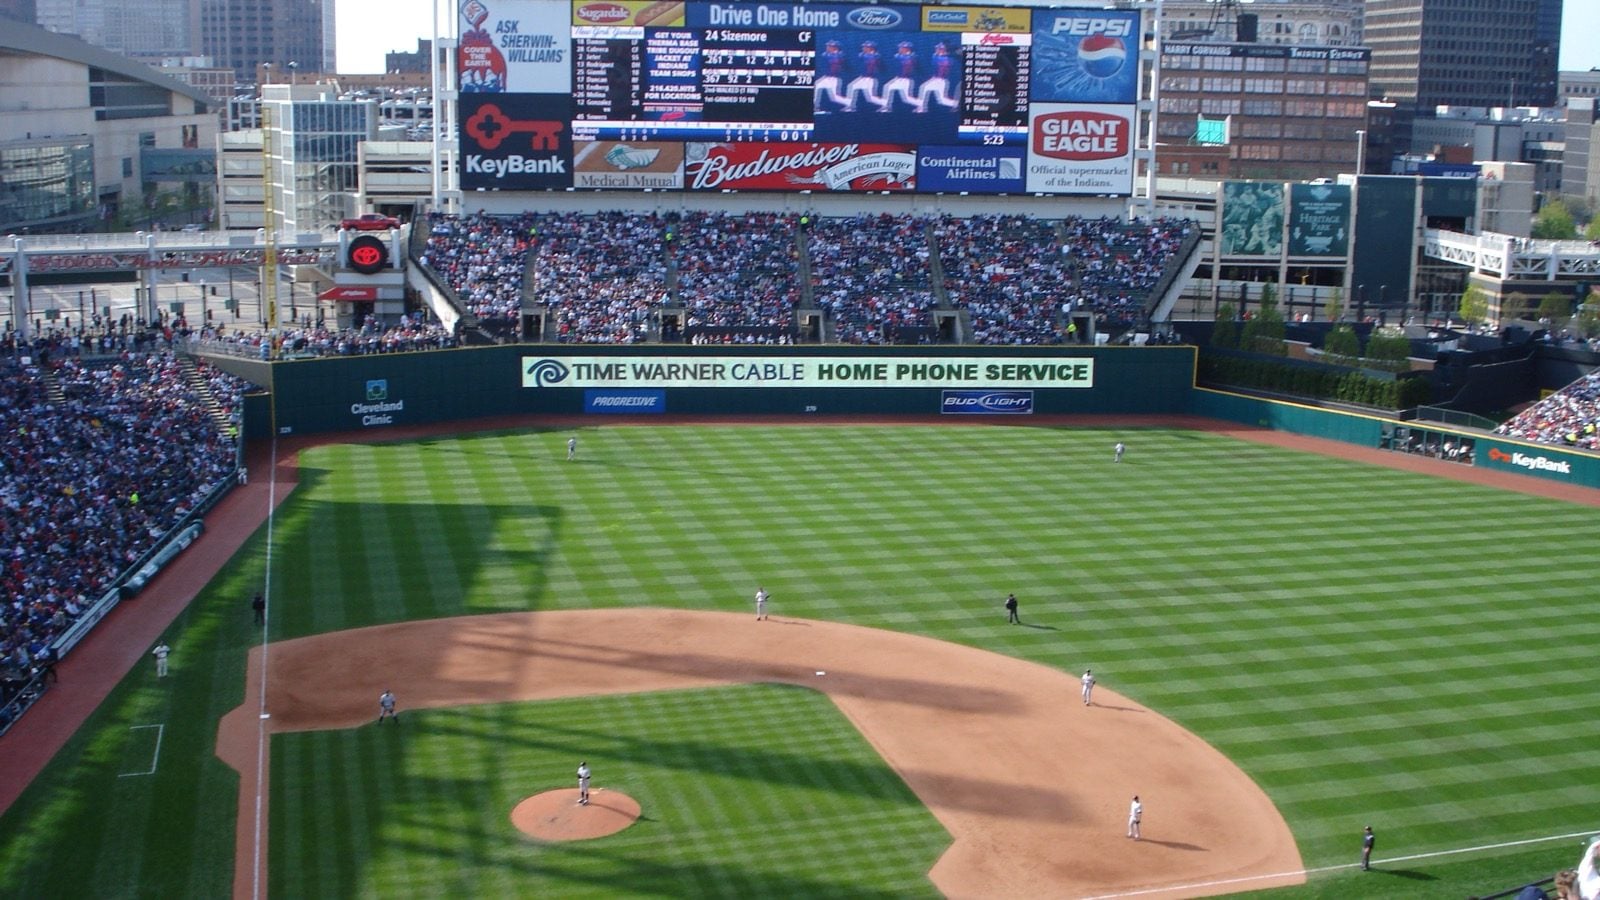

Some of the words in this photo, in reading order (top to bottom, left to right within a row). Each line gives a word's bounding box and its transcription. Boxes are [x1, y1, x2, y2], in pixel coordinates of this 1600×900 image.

[578, 7, 629, 20] Sugardale
[710, 5, 752, 25] Drive
[757, 6, 788, 26] One
[793, 6, 839, 27] Home
[857, 10, 890, 26] Ford
[496, 20, 520, 33] ASK
[1052, 17, 1132, 37] PEPSI
[501, 35, 557, 48] SHERWIN-
[705, 30, 718, 41] 24
[721, 30, 767, 42] Sizemore
[799, 32, 811, 42] CF
[508, 50, 563, 62] WILLIAMS
[1164, 46, 1191, 55] HARRY
[746, 56, 756, 64] 12
[764, 57, 774, 65] 24
[783, 57, 792, 65] 11
[794, 76, 812, 85] .370
[1042, 119, 1121, 136] GIANT
[781, 132, 788, 140] 0
[792, 132, 798, 140] 0
[803, 132, 808, 140] 1
[984, 135, 1004, 145] 5:23
[1043, 136, 1118, 152] EAGLE
[466, 154, 565, 177] KeyBank
[689, 144, 859, 189] Budweiser
[921, 157, 996, 168] Continental
[834, 161, 880, 182] American
[883, 159, 912, 171] Lager
[946, 169, 996, 179] Airlines
[1030, 165, 1066, 175] Official
[1069, 167, 1128, 177] supermarket
[582, 175, 629, 187] Medical
[634, 175, 678, 187] Mutual
[1045, 178, 1055, 186] of
[1058, 178, 1072, 187] the
[1074, 178, 1113, 187] Indians.
[56, 257, 116, 268] TOYOTA
[572, 364, 626, 380] TIME
[632, 364, 725, 380] WARNER
[732, 364, 804, 380] CABLE
[818, 364, 888, 380] HOME
[897, 364, 978, 380] PHONE
[986, 364, 1088, 380] SERVICE
[351, 400, 403, 414] Cleveland
[592, 396, 658, 406] PROGRESSIVE
[985, 398, 1030, 406] LIGHT
[362, 414, 392, 426] Clinic
[1511, 453, 1571, 474] KeyBank
